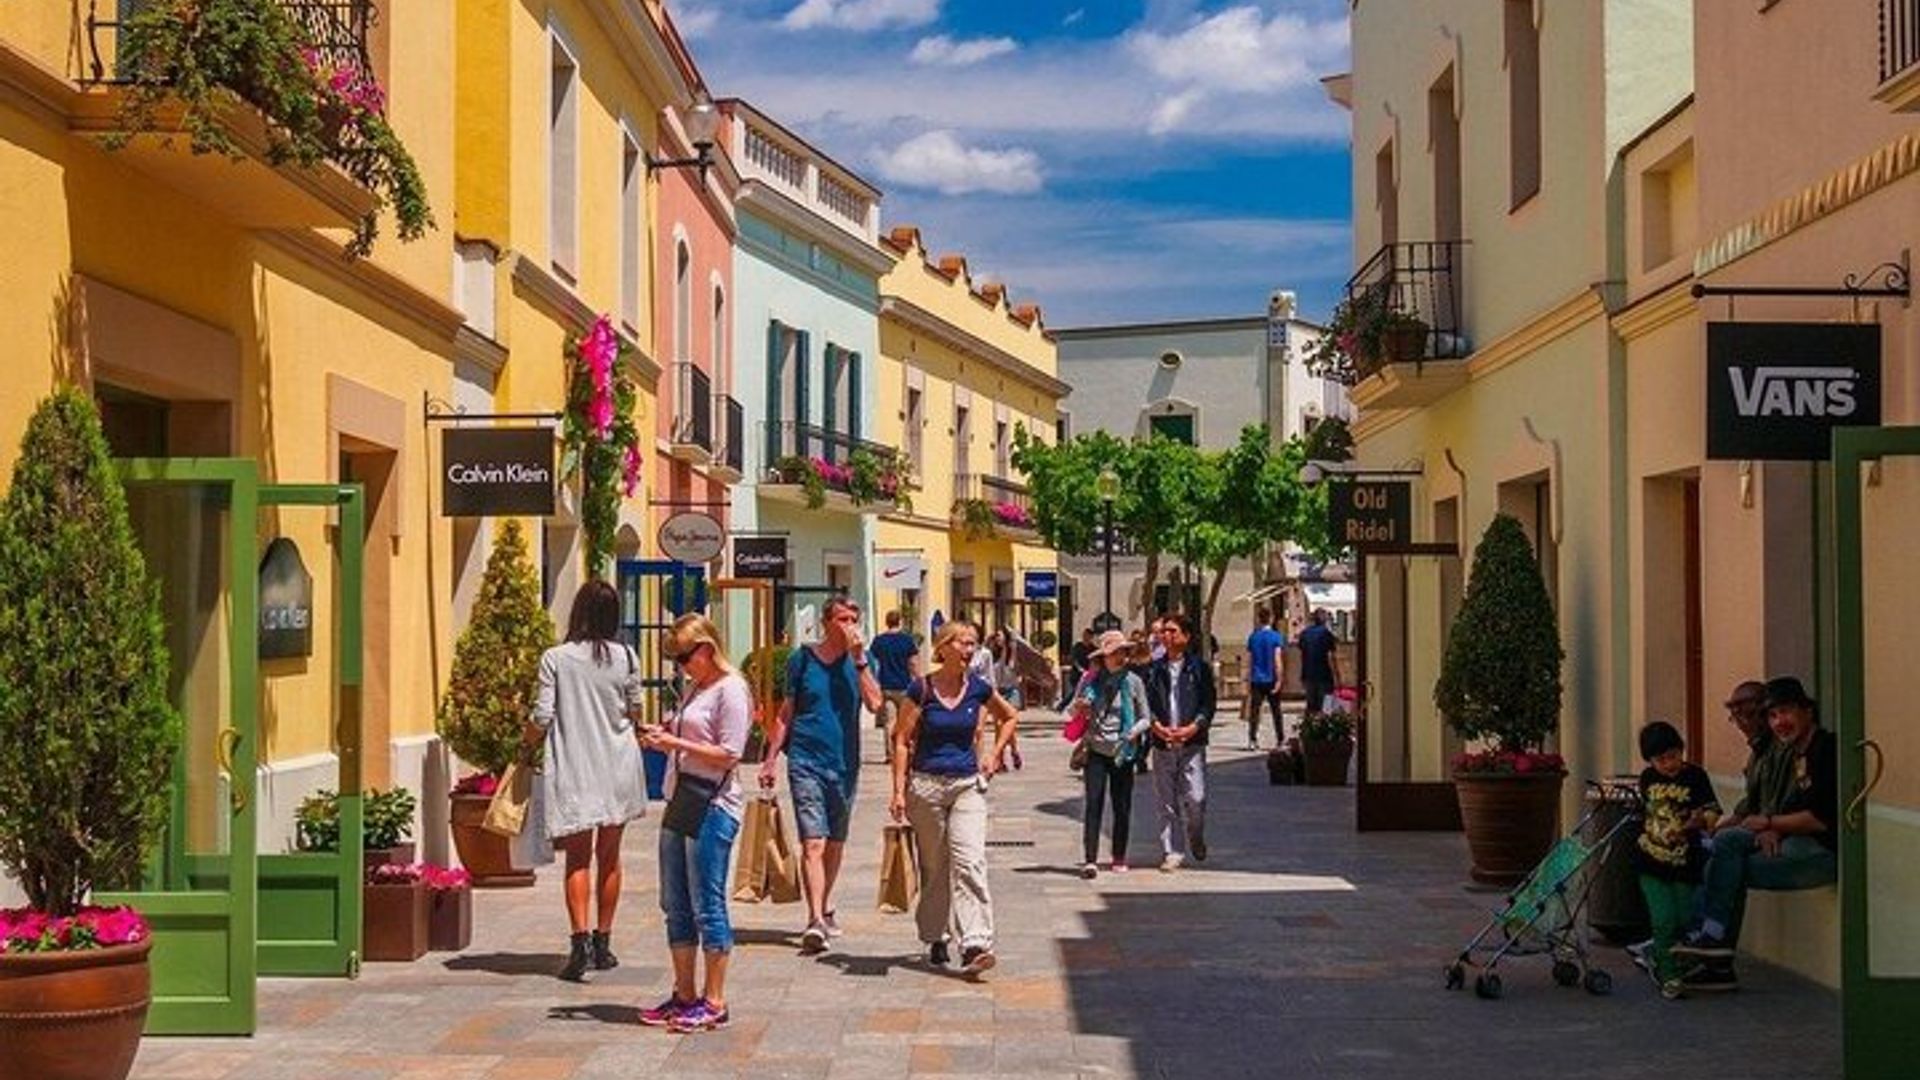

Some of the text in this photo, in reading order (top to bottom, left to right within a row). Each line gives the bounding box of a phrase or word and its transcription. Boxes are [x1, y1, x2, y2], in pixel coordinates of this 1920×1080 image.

[1728, 366, 1857, 417] VANS
[448, 462, 549, 484] Calvin Klein
[1354, 487, 1388, 510] Old
[1347, 518, 1394, 541] Ridel
